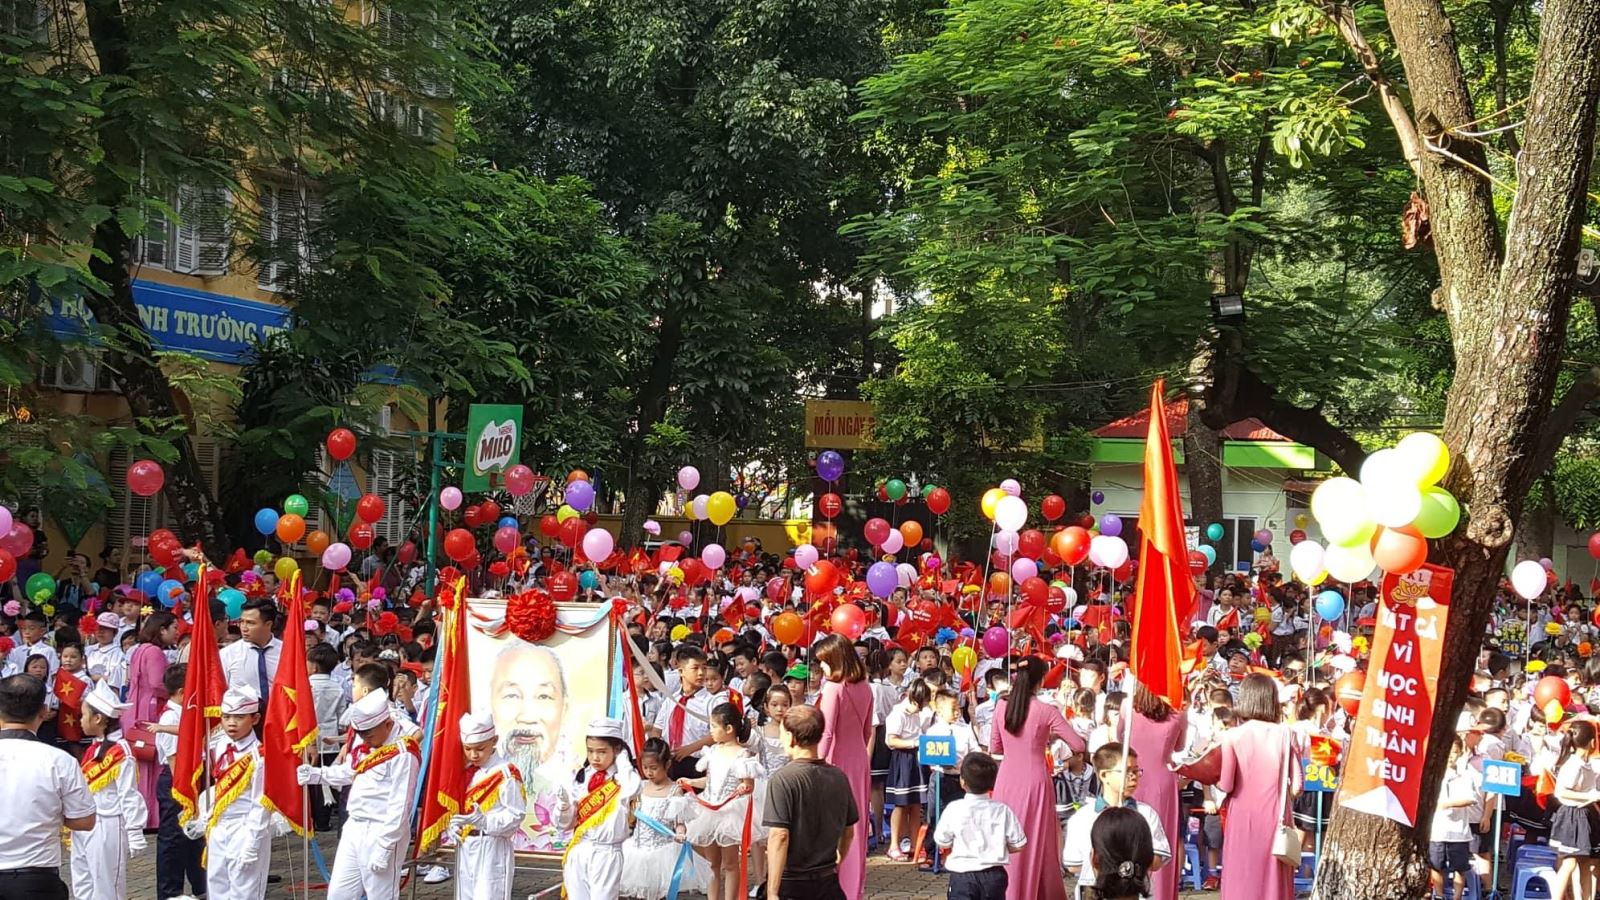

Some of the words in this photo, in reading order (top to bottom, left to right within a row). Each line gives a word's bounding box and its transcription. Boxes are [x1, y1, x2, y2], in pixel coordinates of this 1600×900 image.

[136, 303, 168, 332] NH
[174, 311, 257, 345] TRƯỜNG
[479, 434, 513, 462] MILO
[1393, 640, 1413, 664] VÌ
[1376, 669, 1418, 696] HỌC
[1371, 698, 1415, 726] SINH
[925, 740, 951, 756] 2M
[1365, 725, 1417, 757] THÂN
[1305, 763, 1338, 789] 2Q
[1365, 757, 1407, 782] YÊU
[1485, 764, 1517, 787] 2H
